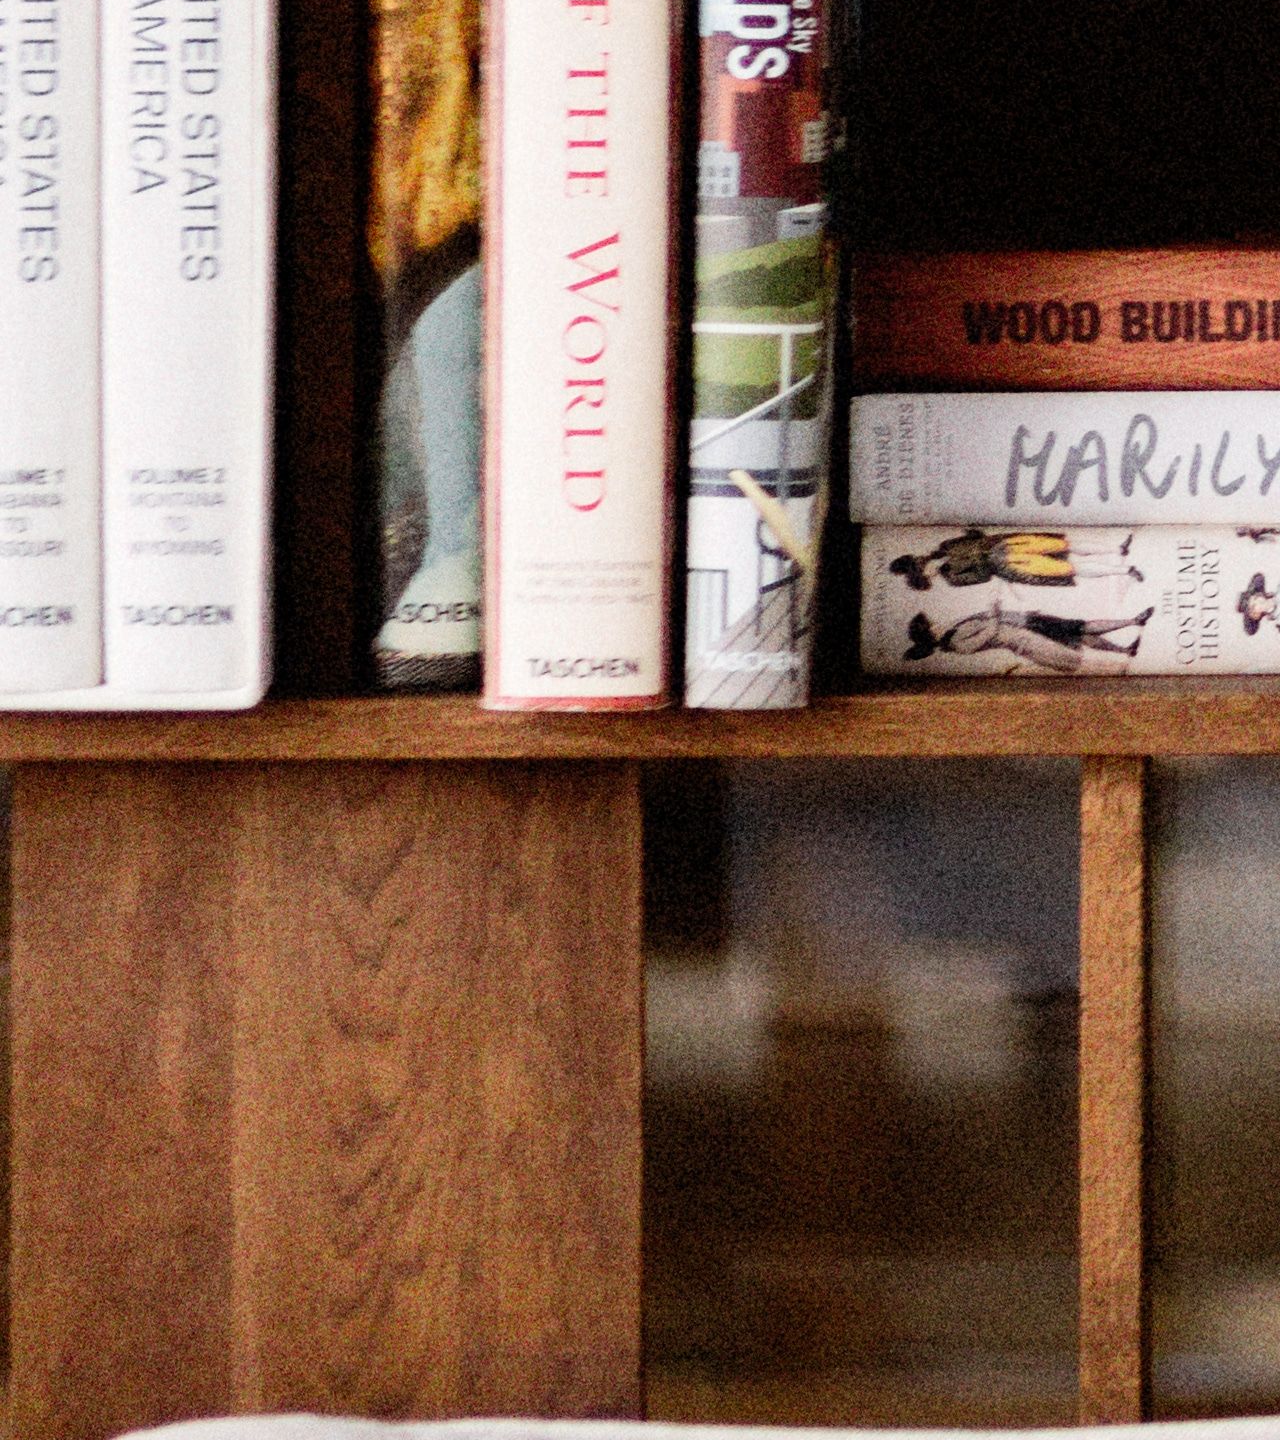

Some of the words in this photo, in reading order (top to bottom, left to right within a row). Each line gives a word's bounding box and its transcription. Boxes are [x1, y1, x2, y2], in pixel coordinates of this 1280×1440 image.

[786, 16, 820, 54] Sky
[566, 52, 612, 202] THE
[20, 112, 60, 285] STATES
[182, 112, 223, 285] STATES
[963, 299, 1100, 346] WOOD
[560, 232, 628, 515] WORLD
[129, 467, 213, 485] VOLUME
[213, 467, 227, 485] 2
[0, 604, 75, 627] CHEN
[121, 604, 236, 627] TASCHEN
[380, 601, 482, 625] ASCHEN
[1162, 589, 1173, 617] THE
[1175, 538, 1198, 666] COSTUME
[1200, 544, 1221, 661] HISTORY
[526, 657, 641, 679] TASCHEN
